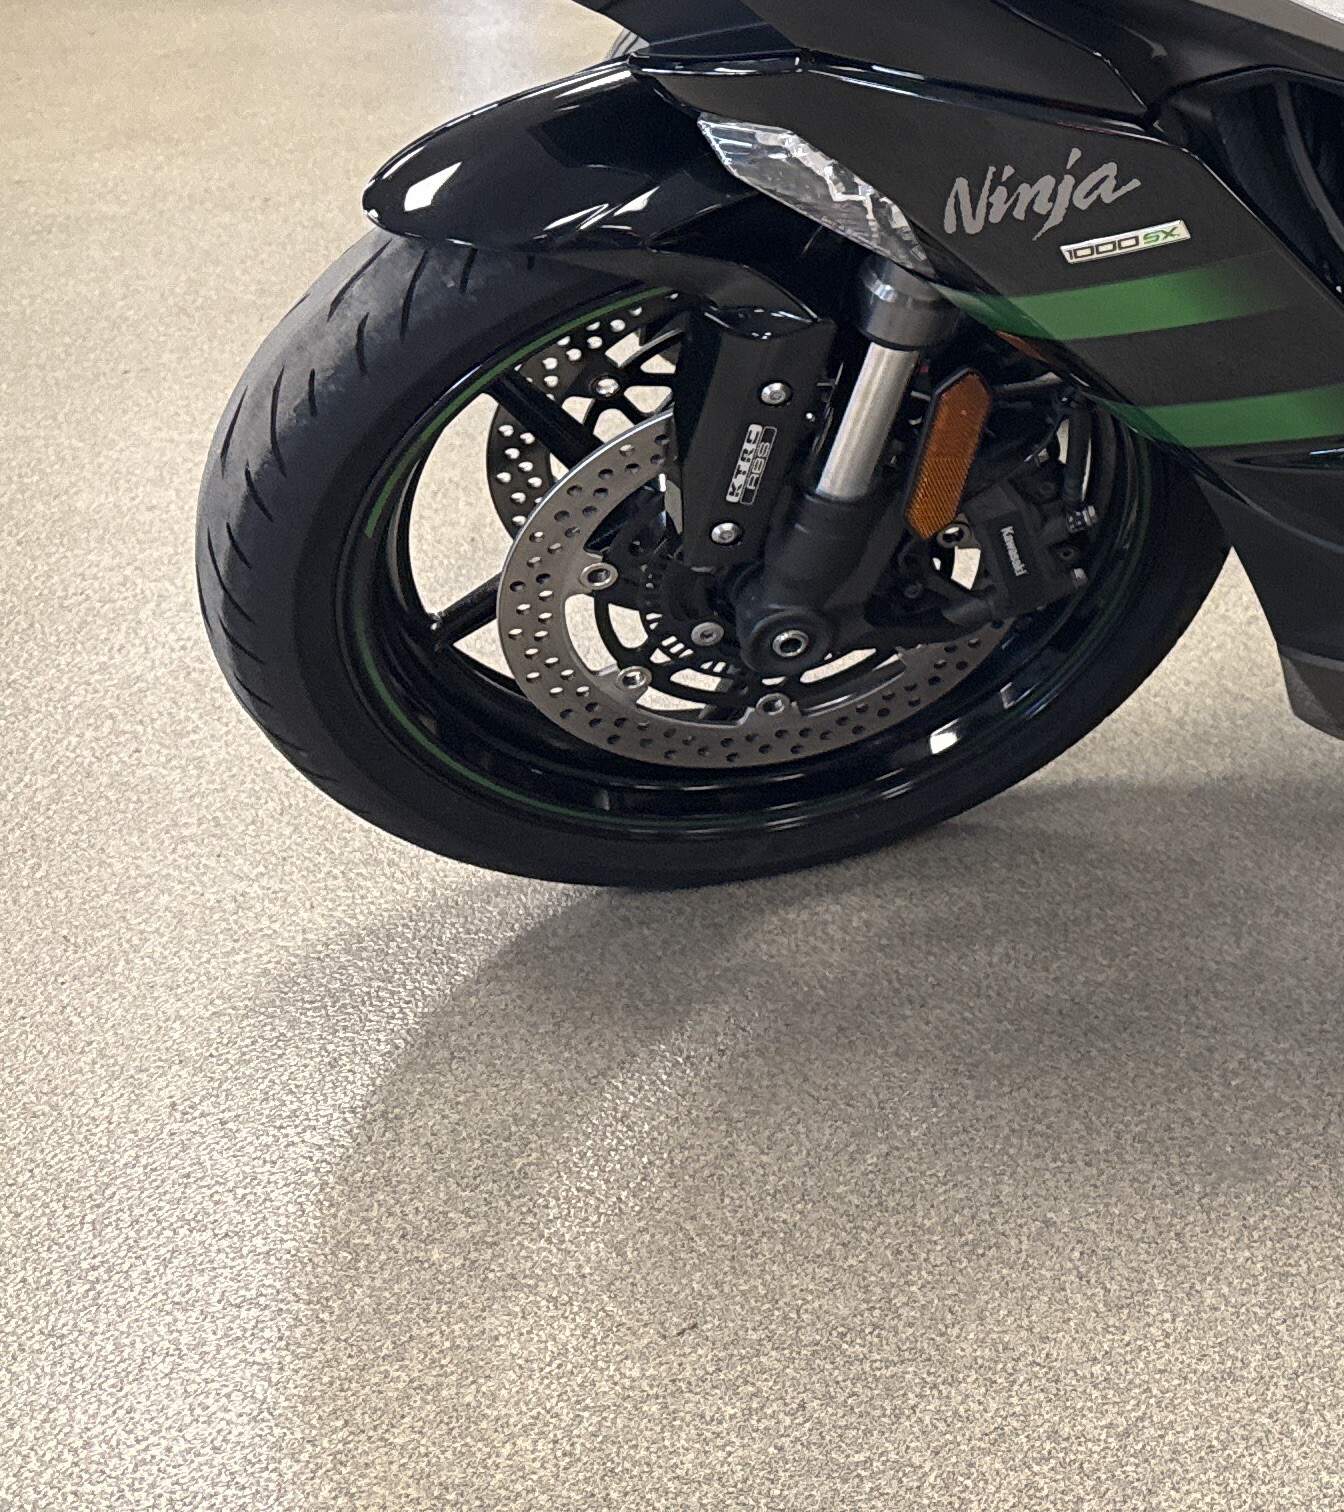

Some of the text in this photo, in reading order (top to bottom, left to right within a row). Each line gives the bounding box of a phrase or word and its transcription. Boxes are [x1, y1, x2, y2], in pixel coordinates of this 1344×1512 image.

[944, 147, 1141, 241] Ninja
[728, 429, 760, 498] KTRC
[746, 441, 771, 490] ABS
[1000, 526, 1028, 577] Kawasaki
